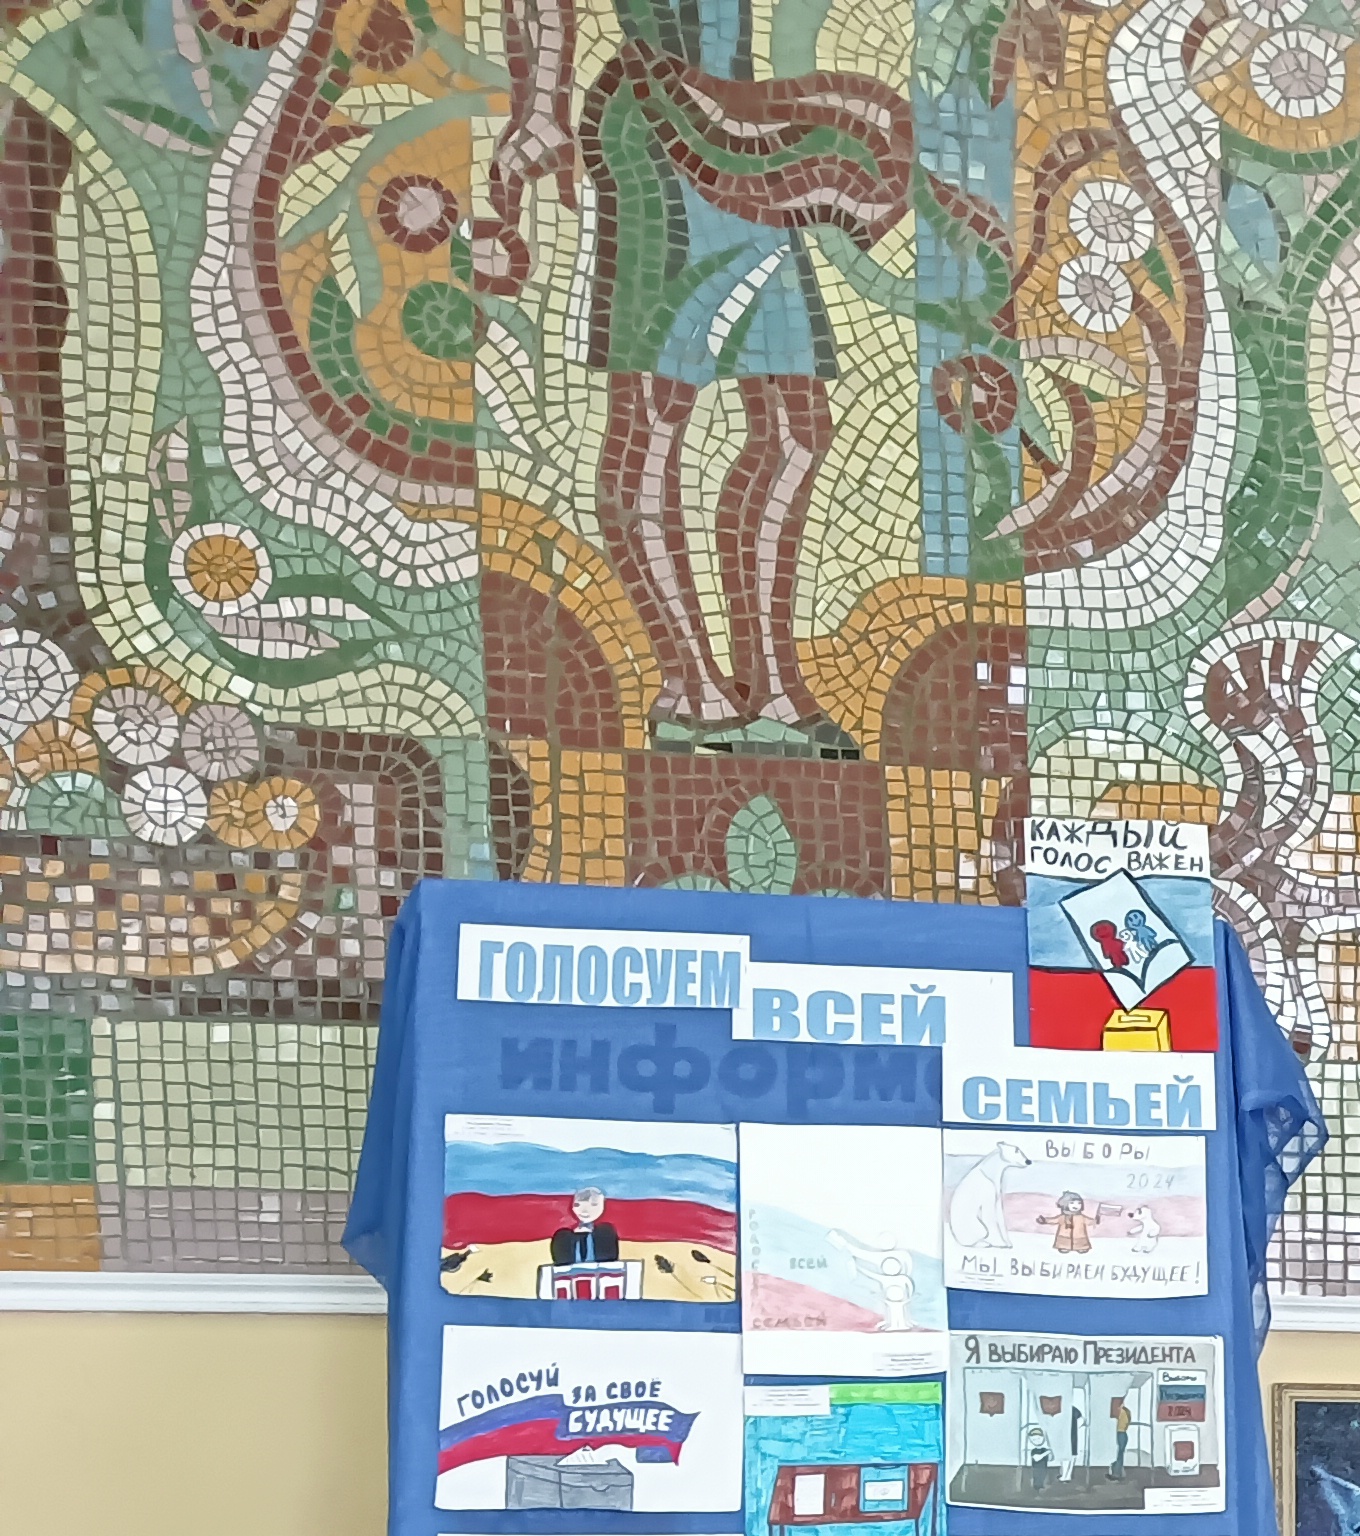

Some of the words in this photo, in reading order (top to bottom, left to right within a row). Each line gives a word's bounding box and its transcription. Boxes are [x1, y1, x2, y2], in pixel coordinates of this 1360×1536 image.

[1031, 819, 1187, 850] КАЖДЫЙ
[1031, 846, 1112, 873] ГОЛОС
[1127, 851, 1203, 872] ВАЖЕН
[479, 940, 741, 1006] ГОЛОСУЕМ
[752, 983, 946, 1045] ВСЕЙ
[500, 1022, 942, 1119] информ
[962, 1075, 1202, 1128] СЕМЬЕЙ
[1045, 1139, 1150, 1159] ВЫБОРЫ
[1127, 1173, 1175, 1189] 2024
[961, 1255, 997, 1273] МЫ
[1010, 1258, 1105, 1282] ВЫБИРАЕМ
[965, 1335, 980, 1364] Я
[988, 1343, 1078, 1364] ВЫБИРАЮ
[457, 1362, 560, 1416] ГОЛОСУЙ
[572, 1386, 596, 1404] ЗА
[568, 1408, 676, 1433] БУДУЩЕЕ
